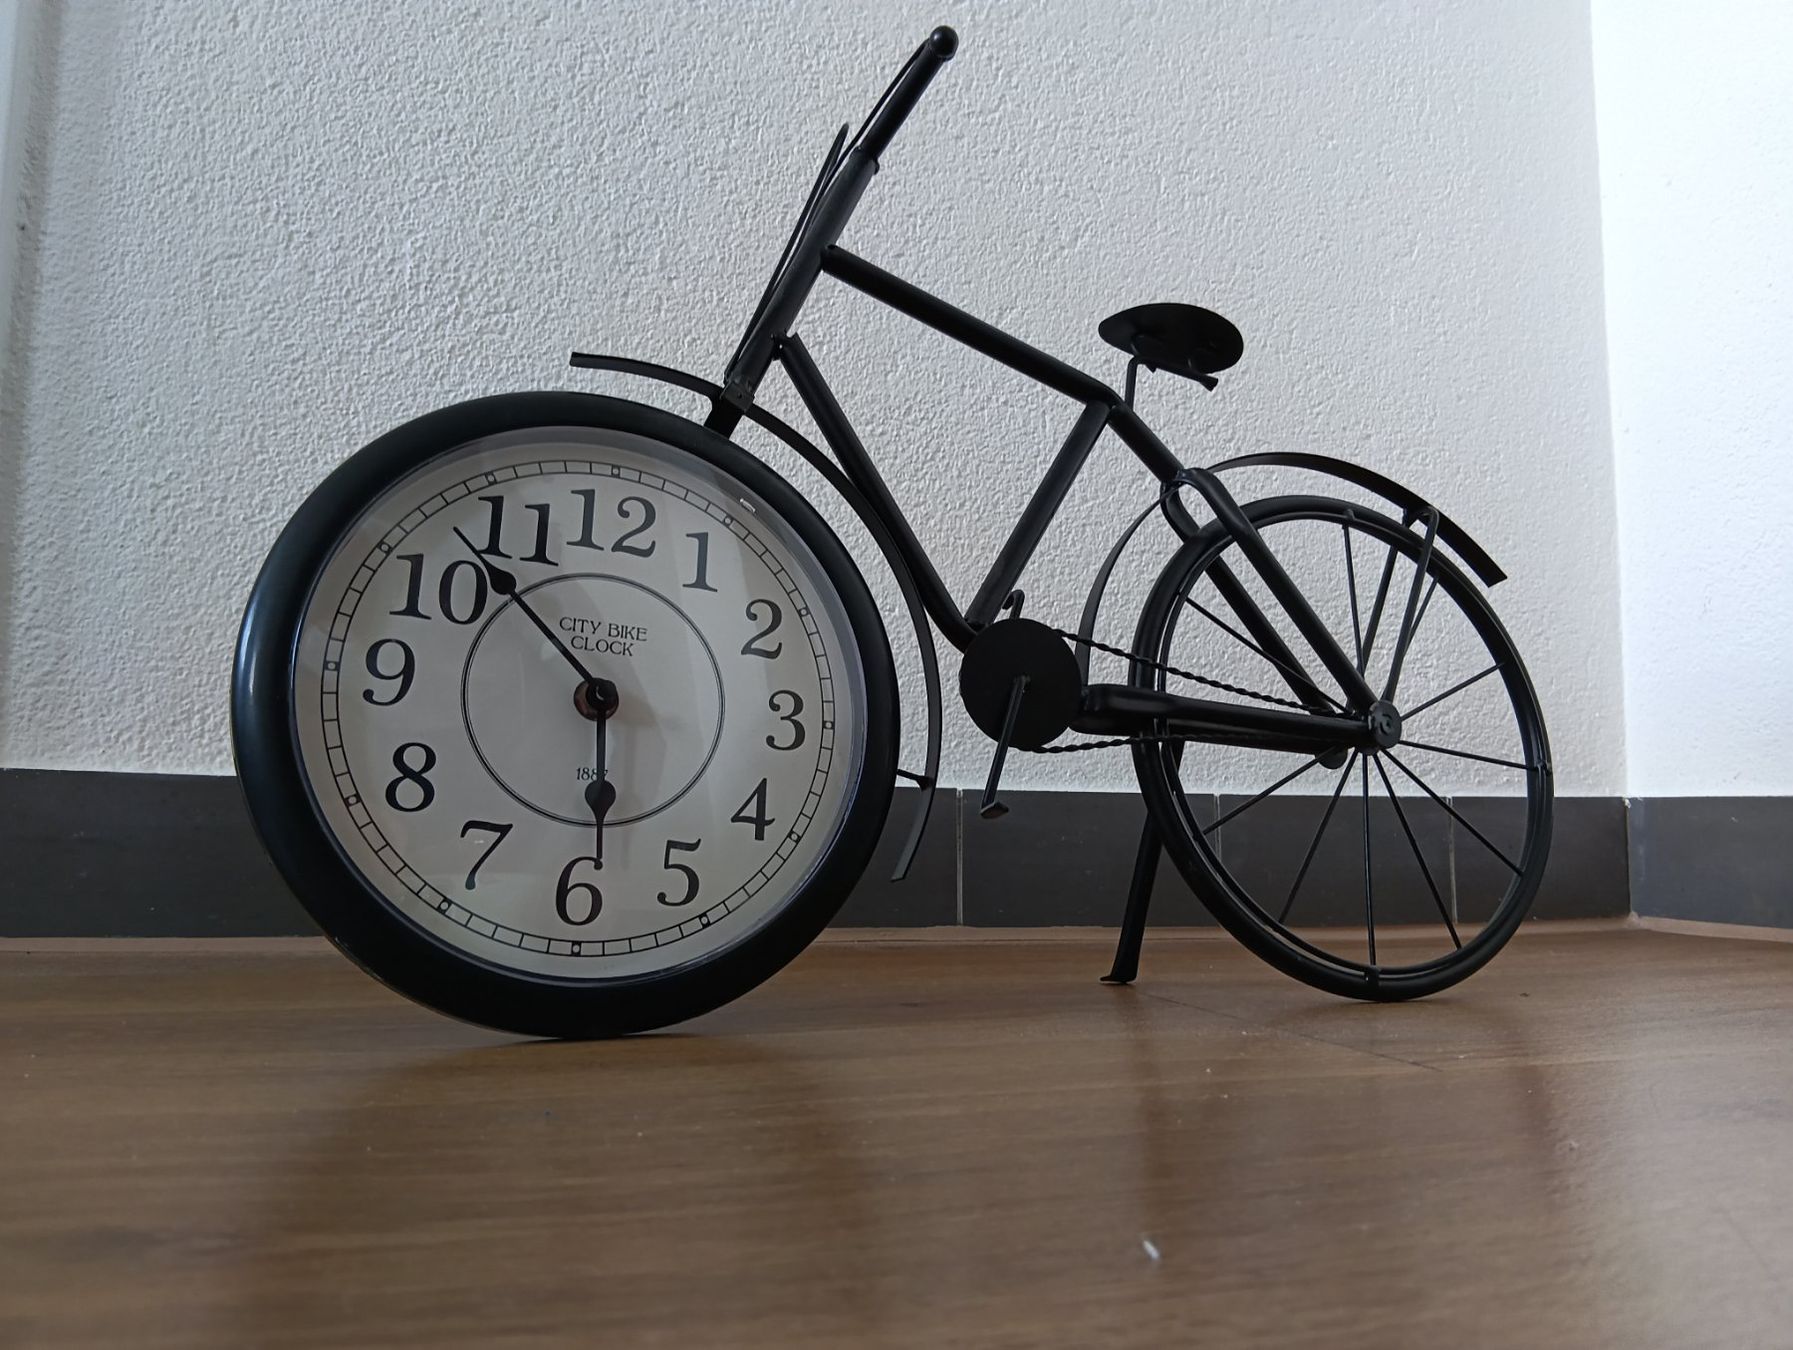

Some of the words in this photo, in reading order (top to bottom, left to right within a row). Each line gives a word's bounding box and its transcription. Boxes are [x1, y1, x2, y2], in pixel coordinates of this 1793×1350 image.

[477, 495, 559, 566] 11
[566, 489, 657, 558] 12
[389, 553, 488, 625] 10
[682, 531, 718, 592] 1
[559, 616, 602, 635] CITY
[608, 622, 648, 642] BIKE
[570, 635, 634, 656] CLOCK
[741, 599, 783, 660] 2
[362, 638, 416, 706] 9
[765, 690, 806, 751] 3
[384, 742, 437, 812] 8
[730, 778, 775, 841] 4
[459, 820, 513, 890] 7
[657, 839, 701, 907] 5
[555, 857, 603, 926] 6
